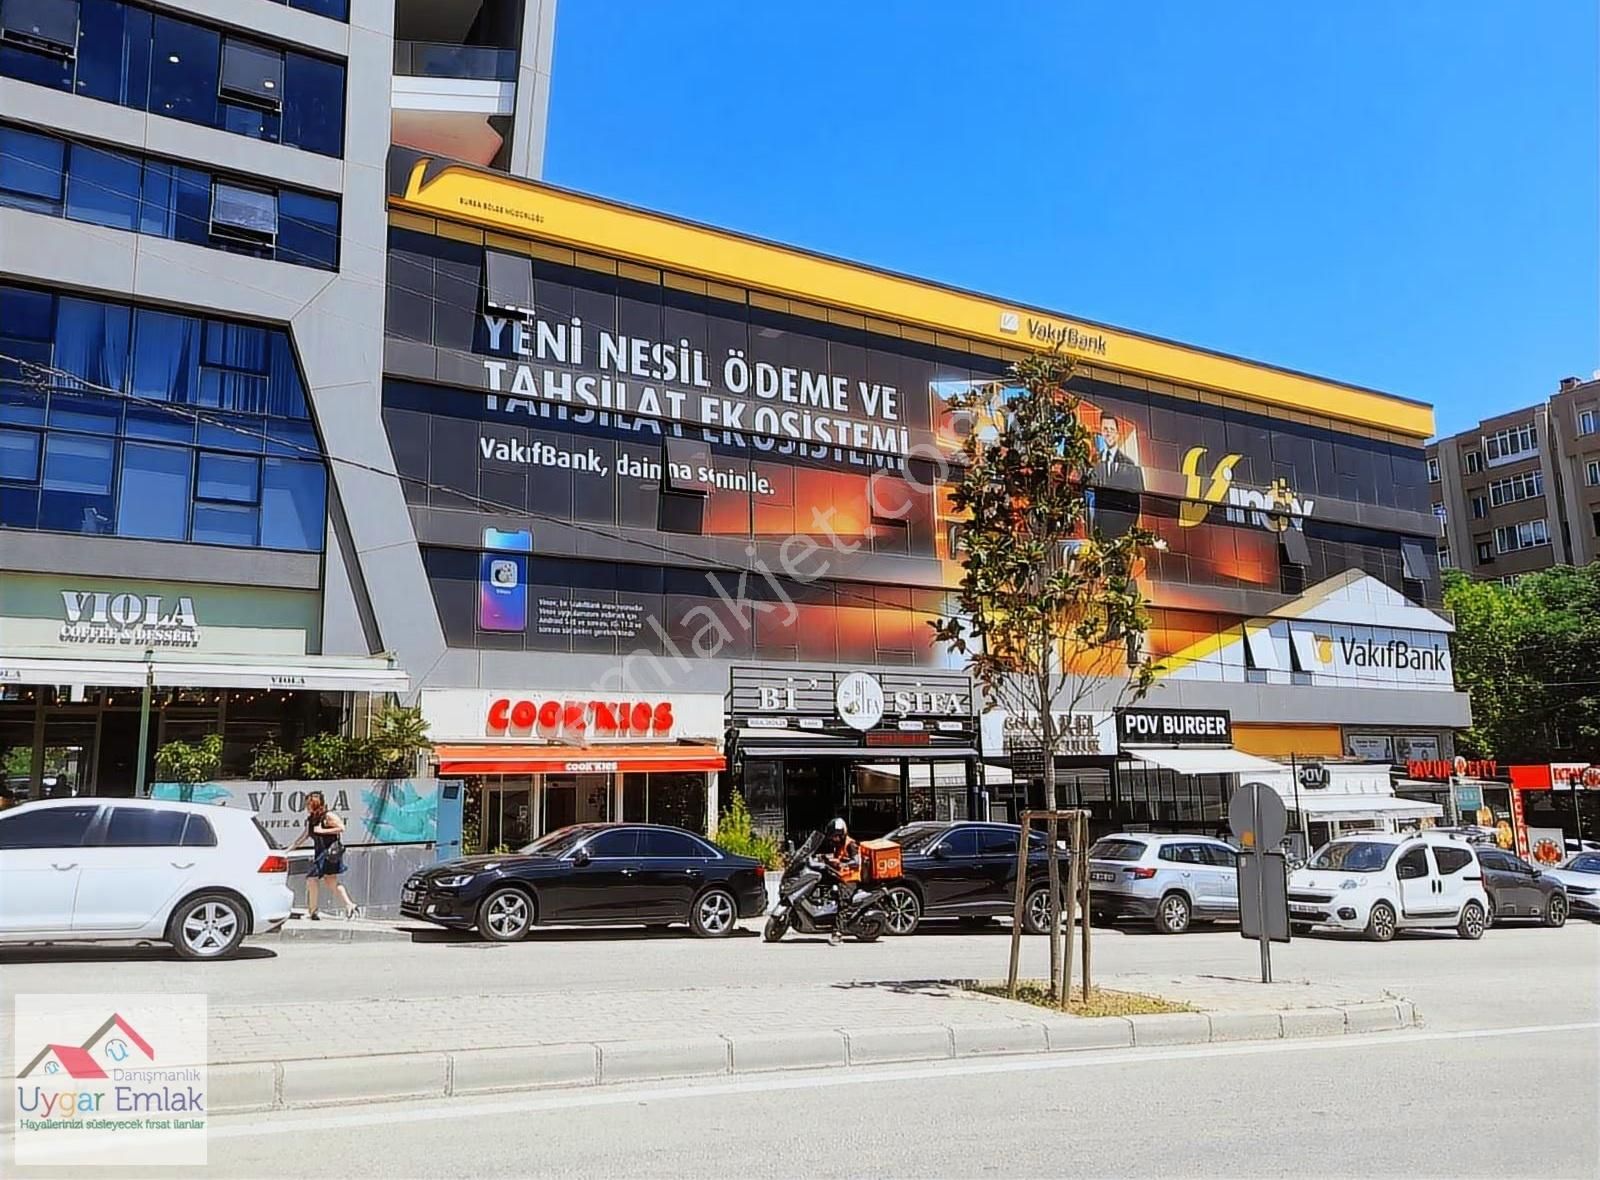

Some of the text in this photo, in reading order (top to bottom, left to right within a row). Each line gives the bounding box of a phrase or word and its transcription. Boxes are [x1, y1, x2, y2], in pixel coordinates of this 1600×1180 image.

[483, 314, 898, 421] YENİ NESİL ÖDEME VE
[484, 361, 687, 437] TAHSİLAT
[61, 590, 198, 628] VIOLA
[60, 625, 118, 642] COFFEE
[135, 628, 200, 644] DESSERT
[1340, 636, 1446, 671] VakıfBank
[271, 675, 305, 684] VIOLA
[895, 682, 964, 719] ŞİFA
[1125, 714, 1227, 735] POV BURGER
[1298, 768, 1323, 782] POV
[248, 790, 350, 813] VIOA
[258, 819, 290, 828] OFFEE
